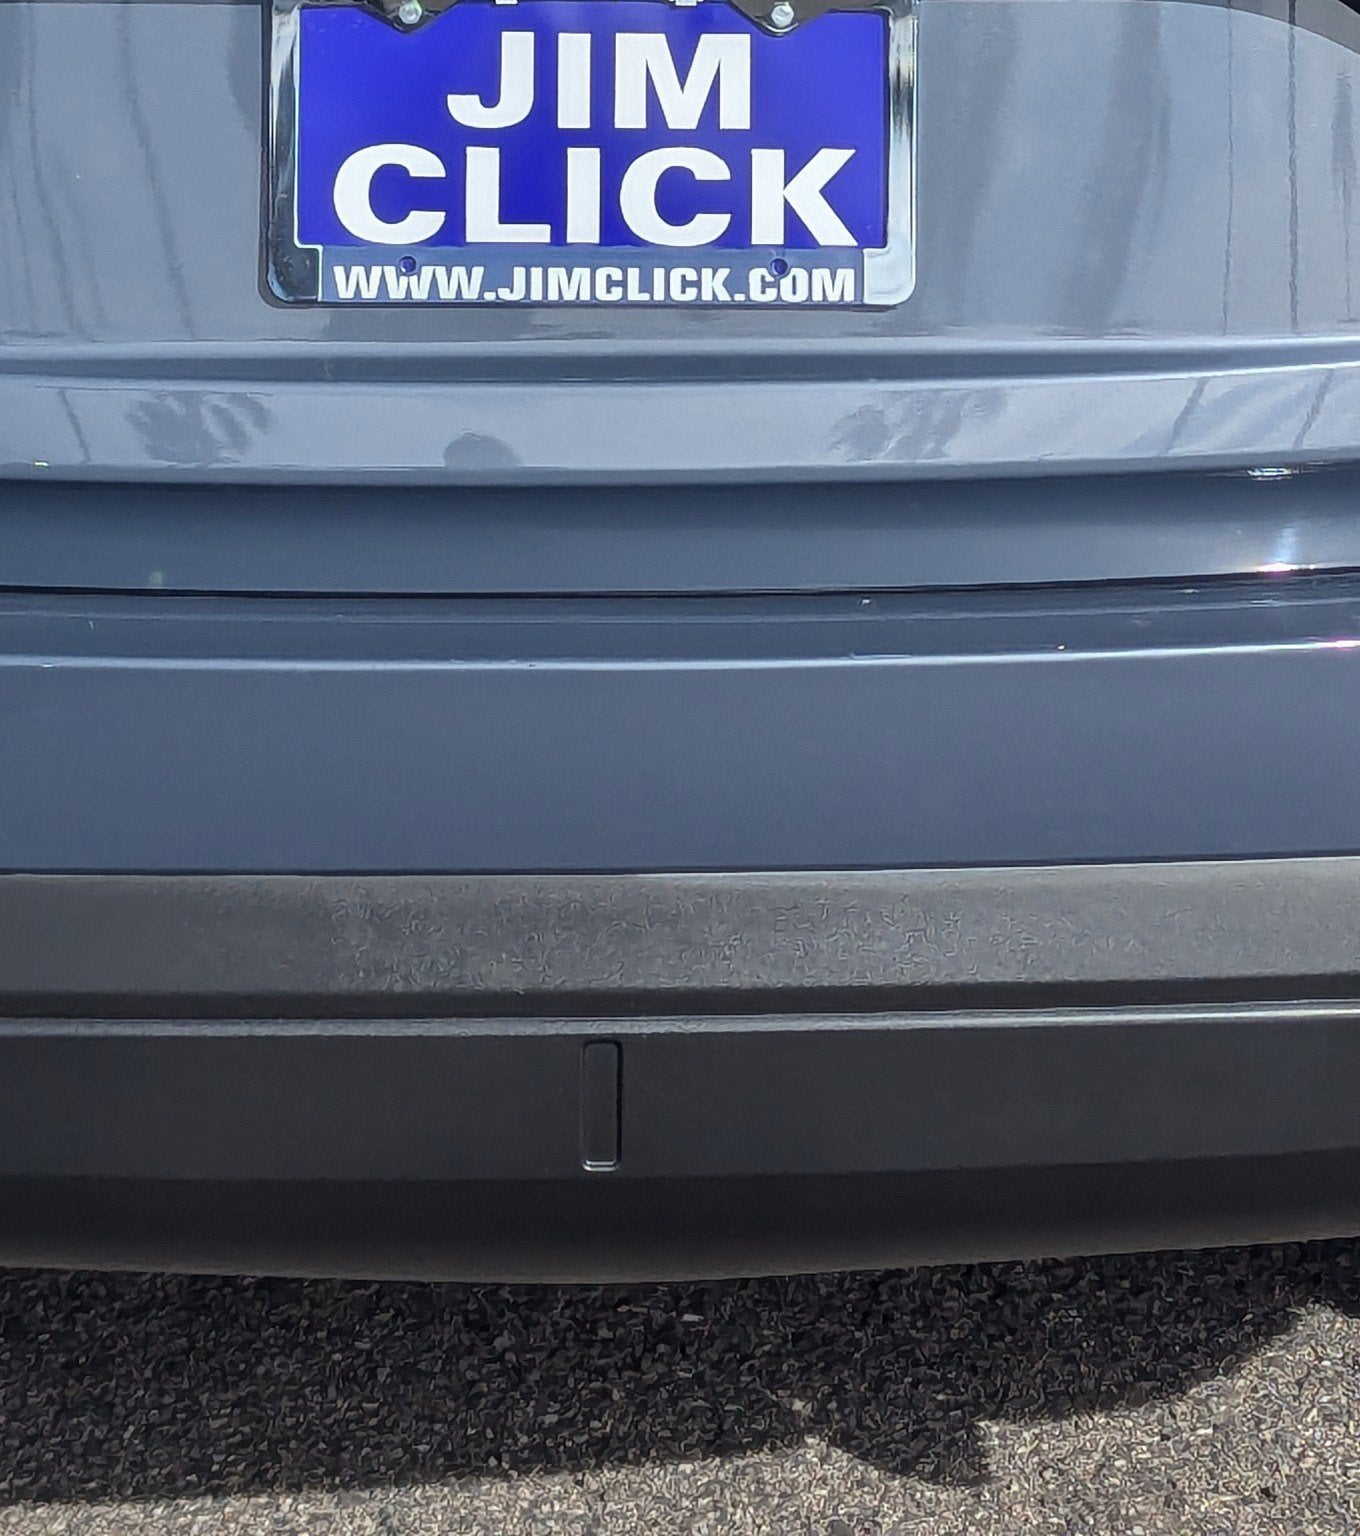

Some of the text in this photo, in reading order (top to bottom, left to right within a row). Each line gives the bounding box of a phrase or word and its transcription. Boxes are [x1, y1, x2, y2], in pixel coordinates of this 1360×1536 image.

[447, 30, 752, 130] JIM
[332, 143, 859, 248] CLICK
[333, 265, 857, 304] WWW.JIMCLICK.COM
